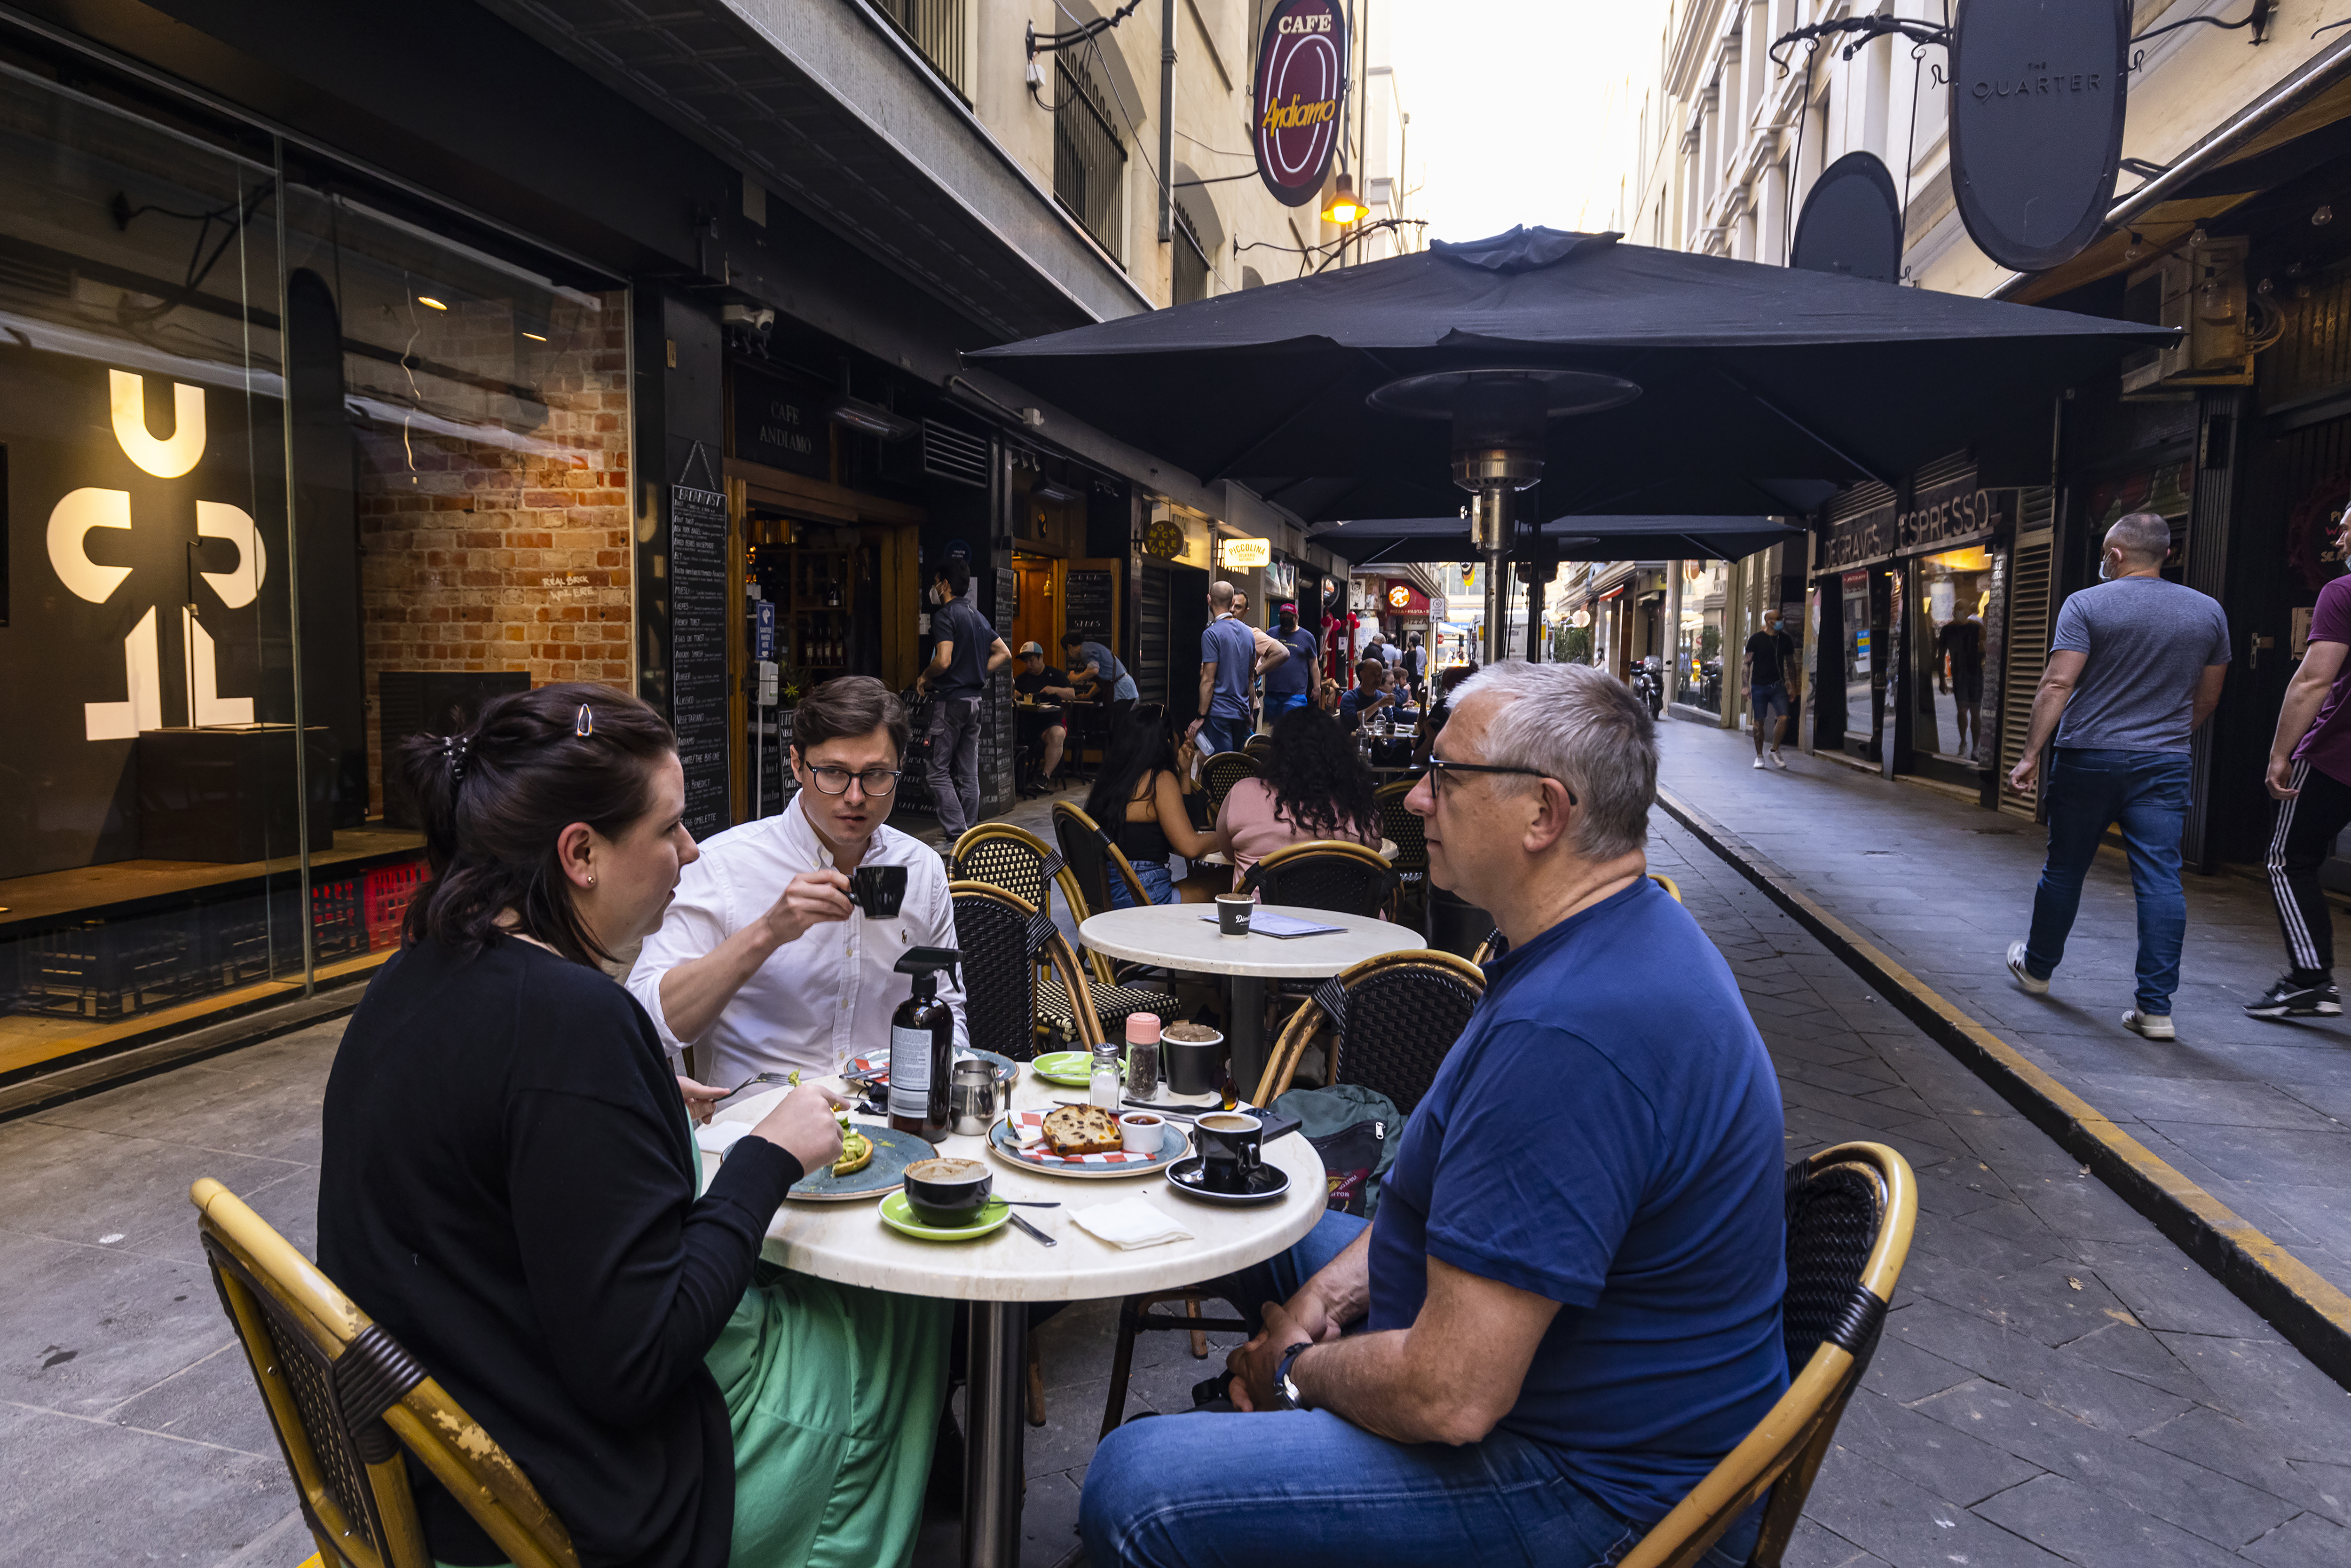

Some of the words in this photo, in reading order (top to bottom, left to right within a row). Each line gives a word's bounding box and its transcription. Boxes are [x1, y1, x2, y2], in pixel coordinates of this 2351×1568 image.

[1278, 8, 1332, 35] CAFÉ
[1972, 73, 2101, 104] QUARTER
[1262, 94, 1336, 137] Andiamo
[759, 424, 812, 454] ANDIAMO
[679, 489, 722, 507] BREAKFAST
[1898, 489, 1989, 548] ESPRESSO
[1149, 524, 1176, 538] MOCK
[1148, 539, 1177, 557] TURTLE
[1228, 543, 1265, 556] PICCOLINA
[542, 576, 566, 588] REAL
[566, 575, 589, 586] BRICK
[675, 634, 686, 643] EGGS
[677, 713, 704, 724] VEGETARIANO
[691, 779, 710, 790] BENEDICT
[685, 818, 693, 827] EGG
[694, 813, 716, 826] OMELETTE
